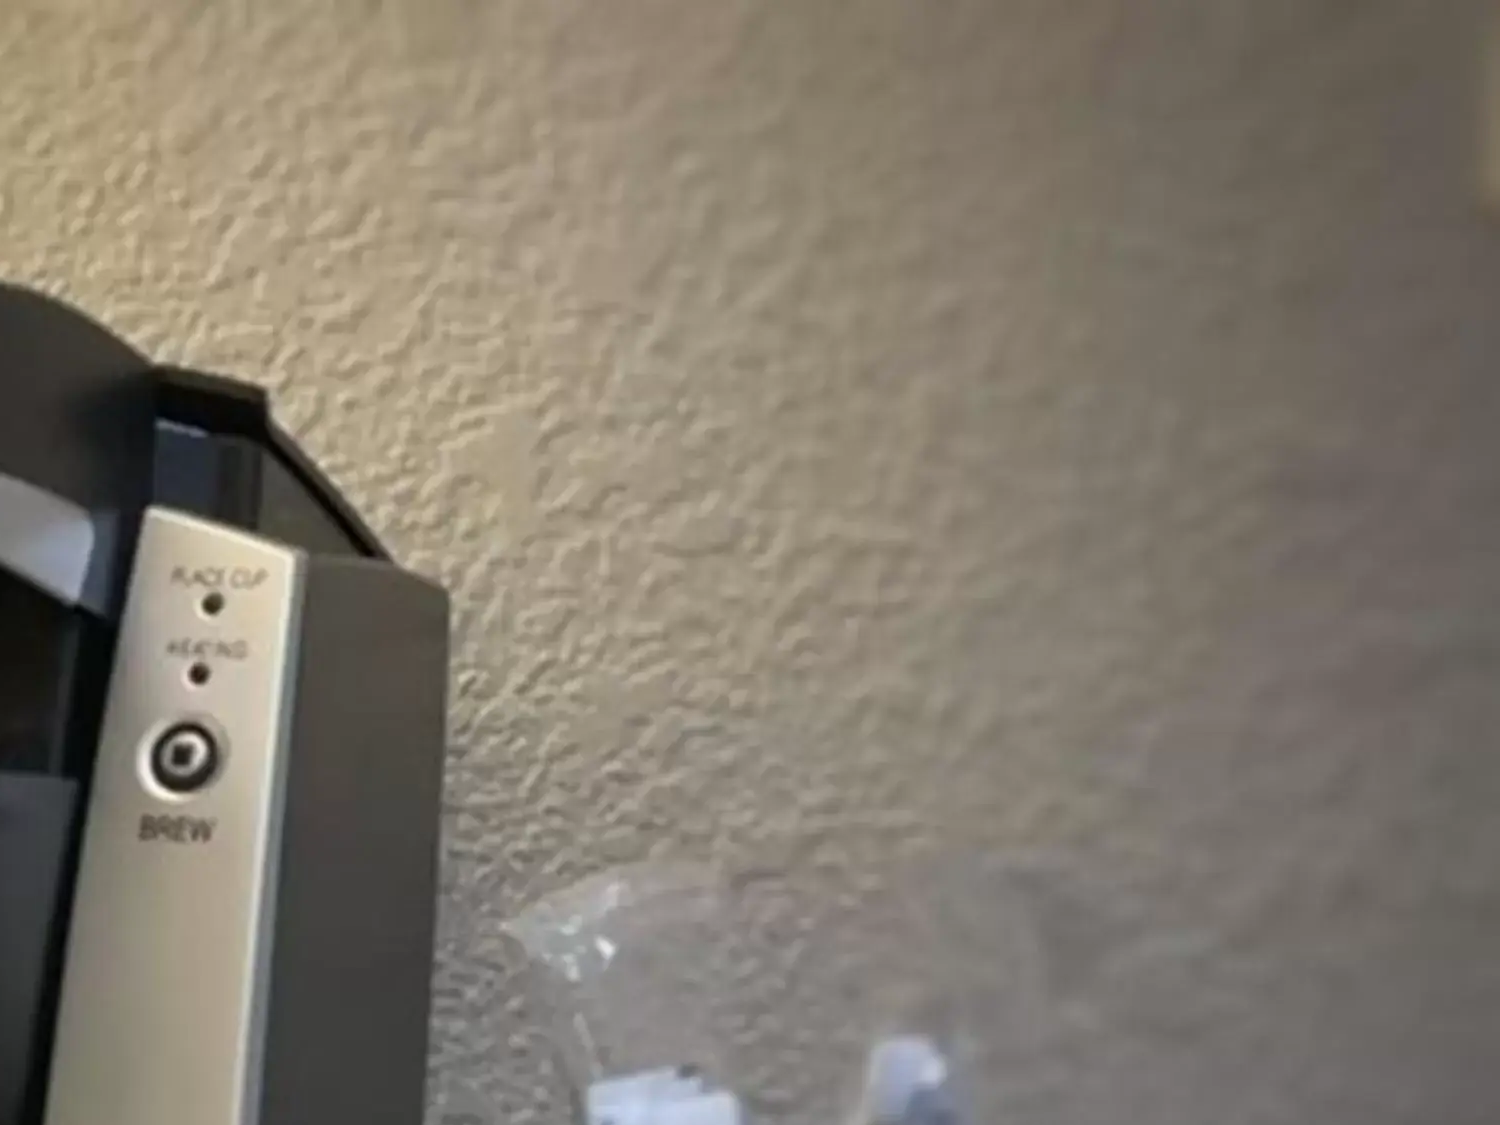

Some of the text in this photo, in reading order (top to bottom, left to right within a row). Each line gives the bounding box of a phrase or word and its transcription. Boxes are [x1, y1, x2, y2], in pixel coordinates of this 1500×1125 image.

[171, 565, 269, 590] PLACE CUP
[138, 813, 218, 844] BREW
